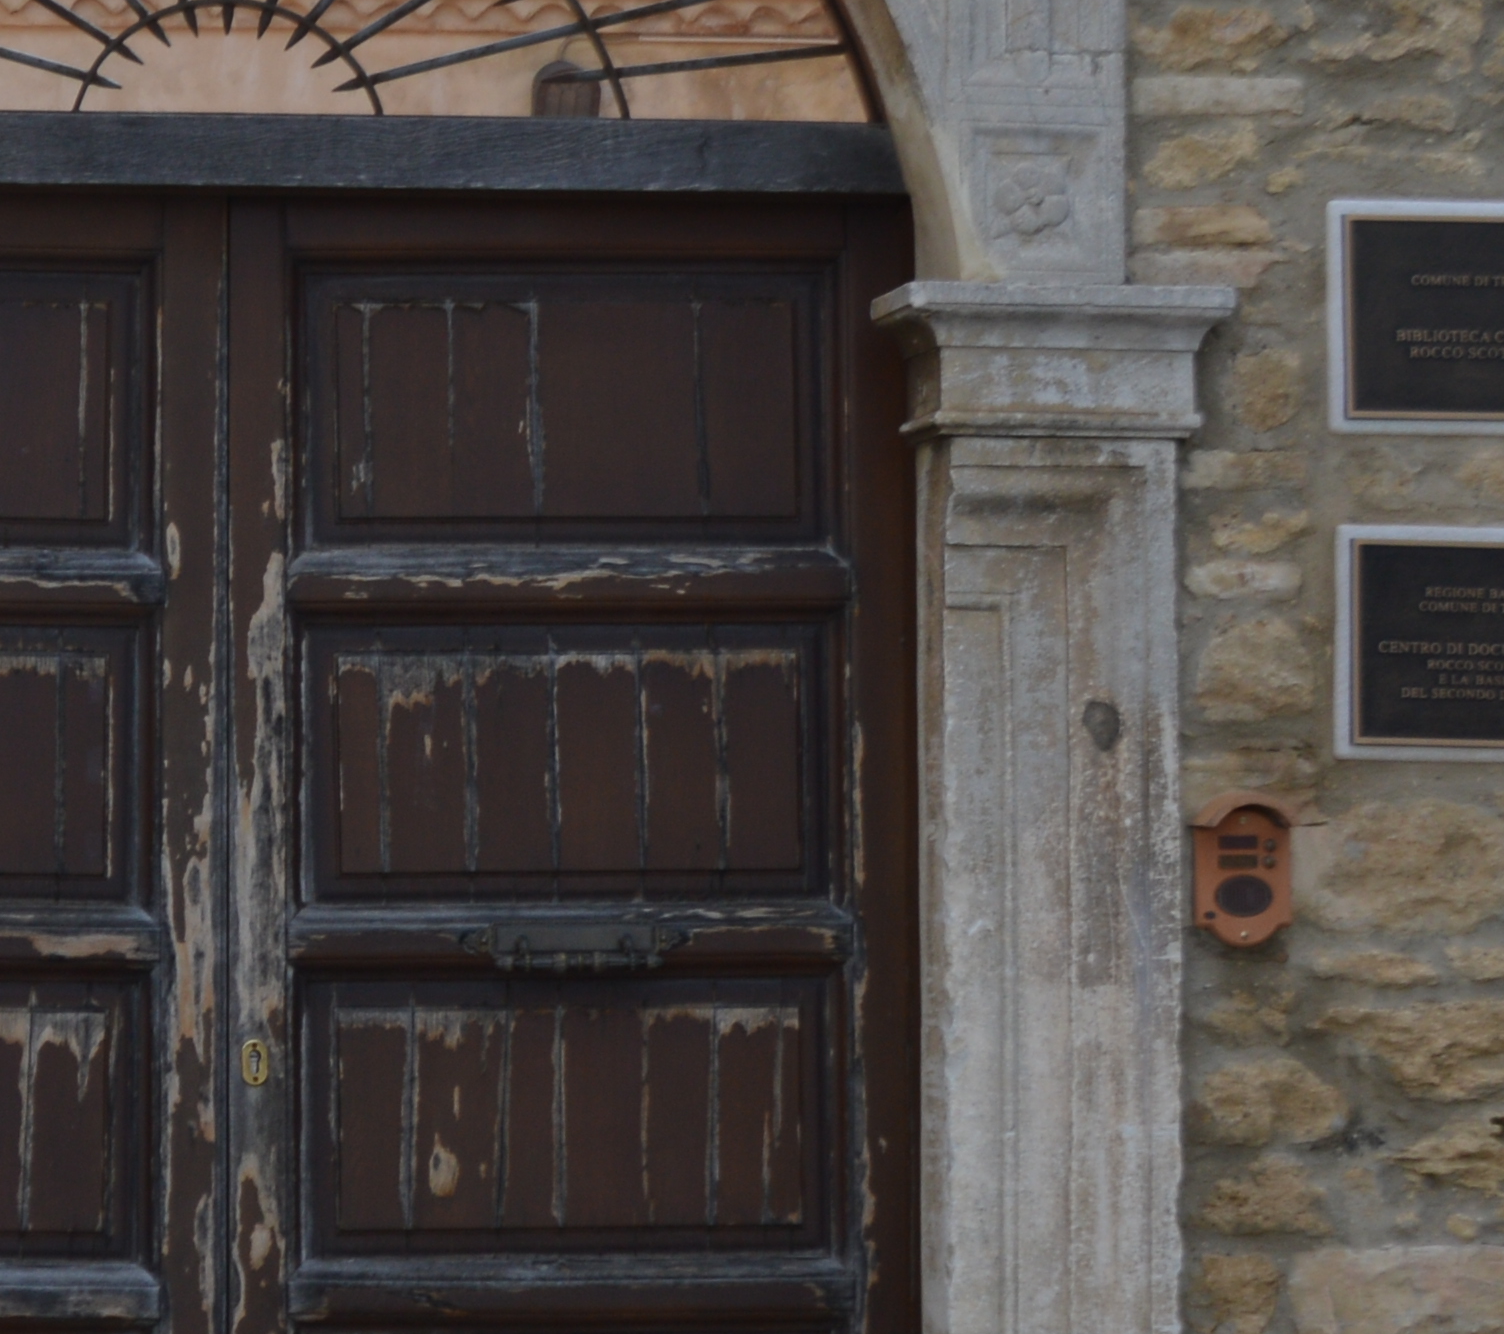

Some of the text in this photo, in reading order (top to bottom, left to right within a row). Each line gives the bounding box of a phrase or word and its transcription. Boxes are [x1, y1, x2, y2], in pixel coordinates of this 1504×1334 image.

[1411, 274, 1471, 286] COMUNE
[1474, 275, 1487, 286] DI
[1396, 329, 1490, 342] BIBLIOTECA
[1410, 347, 1463, 359] ROCCO
[1425, 587, 1485, 598] REGIONE
[1419, 602, 1477, 613] COMUNE
[1482, 602, 1497, 613] DI
[1378, 640, 1441, 654] CENTRO
[1446, 642, 1462, 655] DI
[1427, 659, 1474, 670] ROCCO
[1438, 674, 1446, 684] E
[1451, 674, 1468, 685] LA
[1401, 687, 1427, 699] DEL
[1432, 688, 1495, 700] SECONDO
